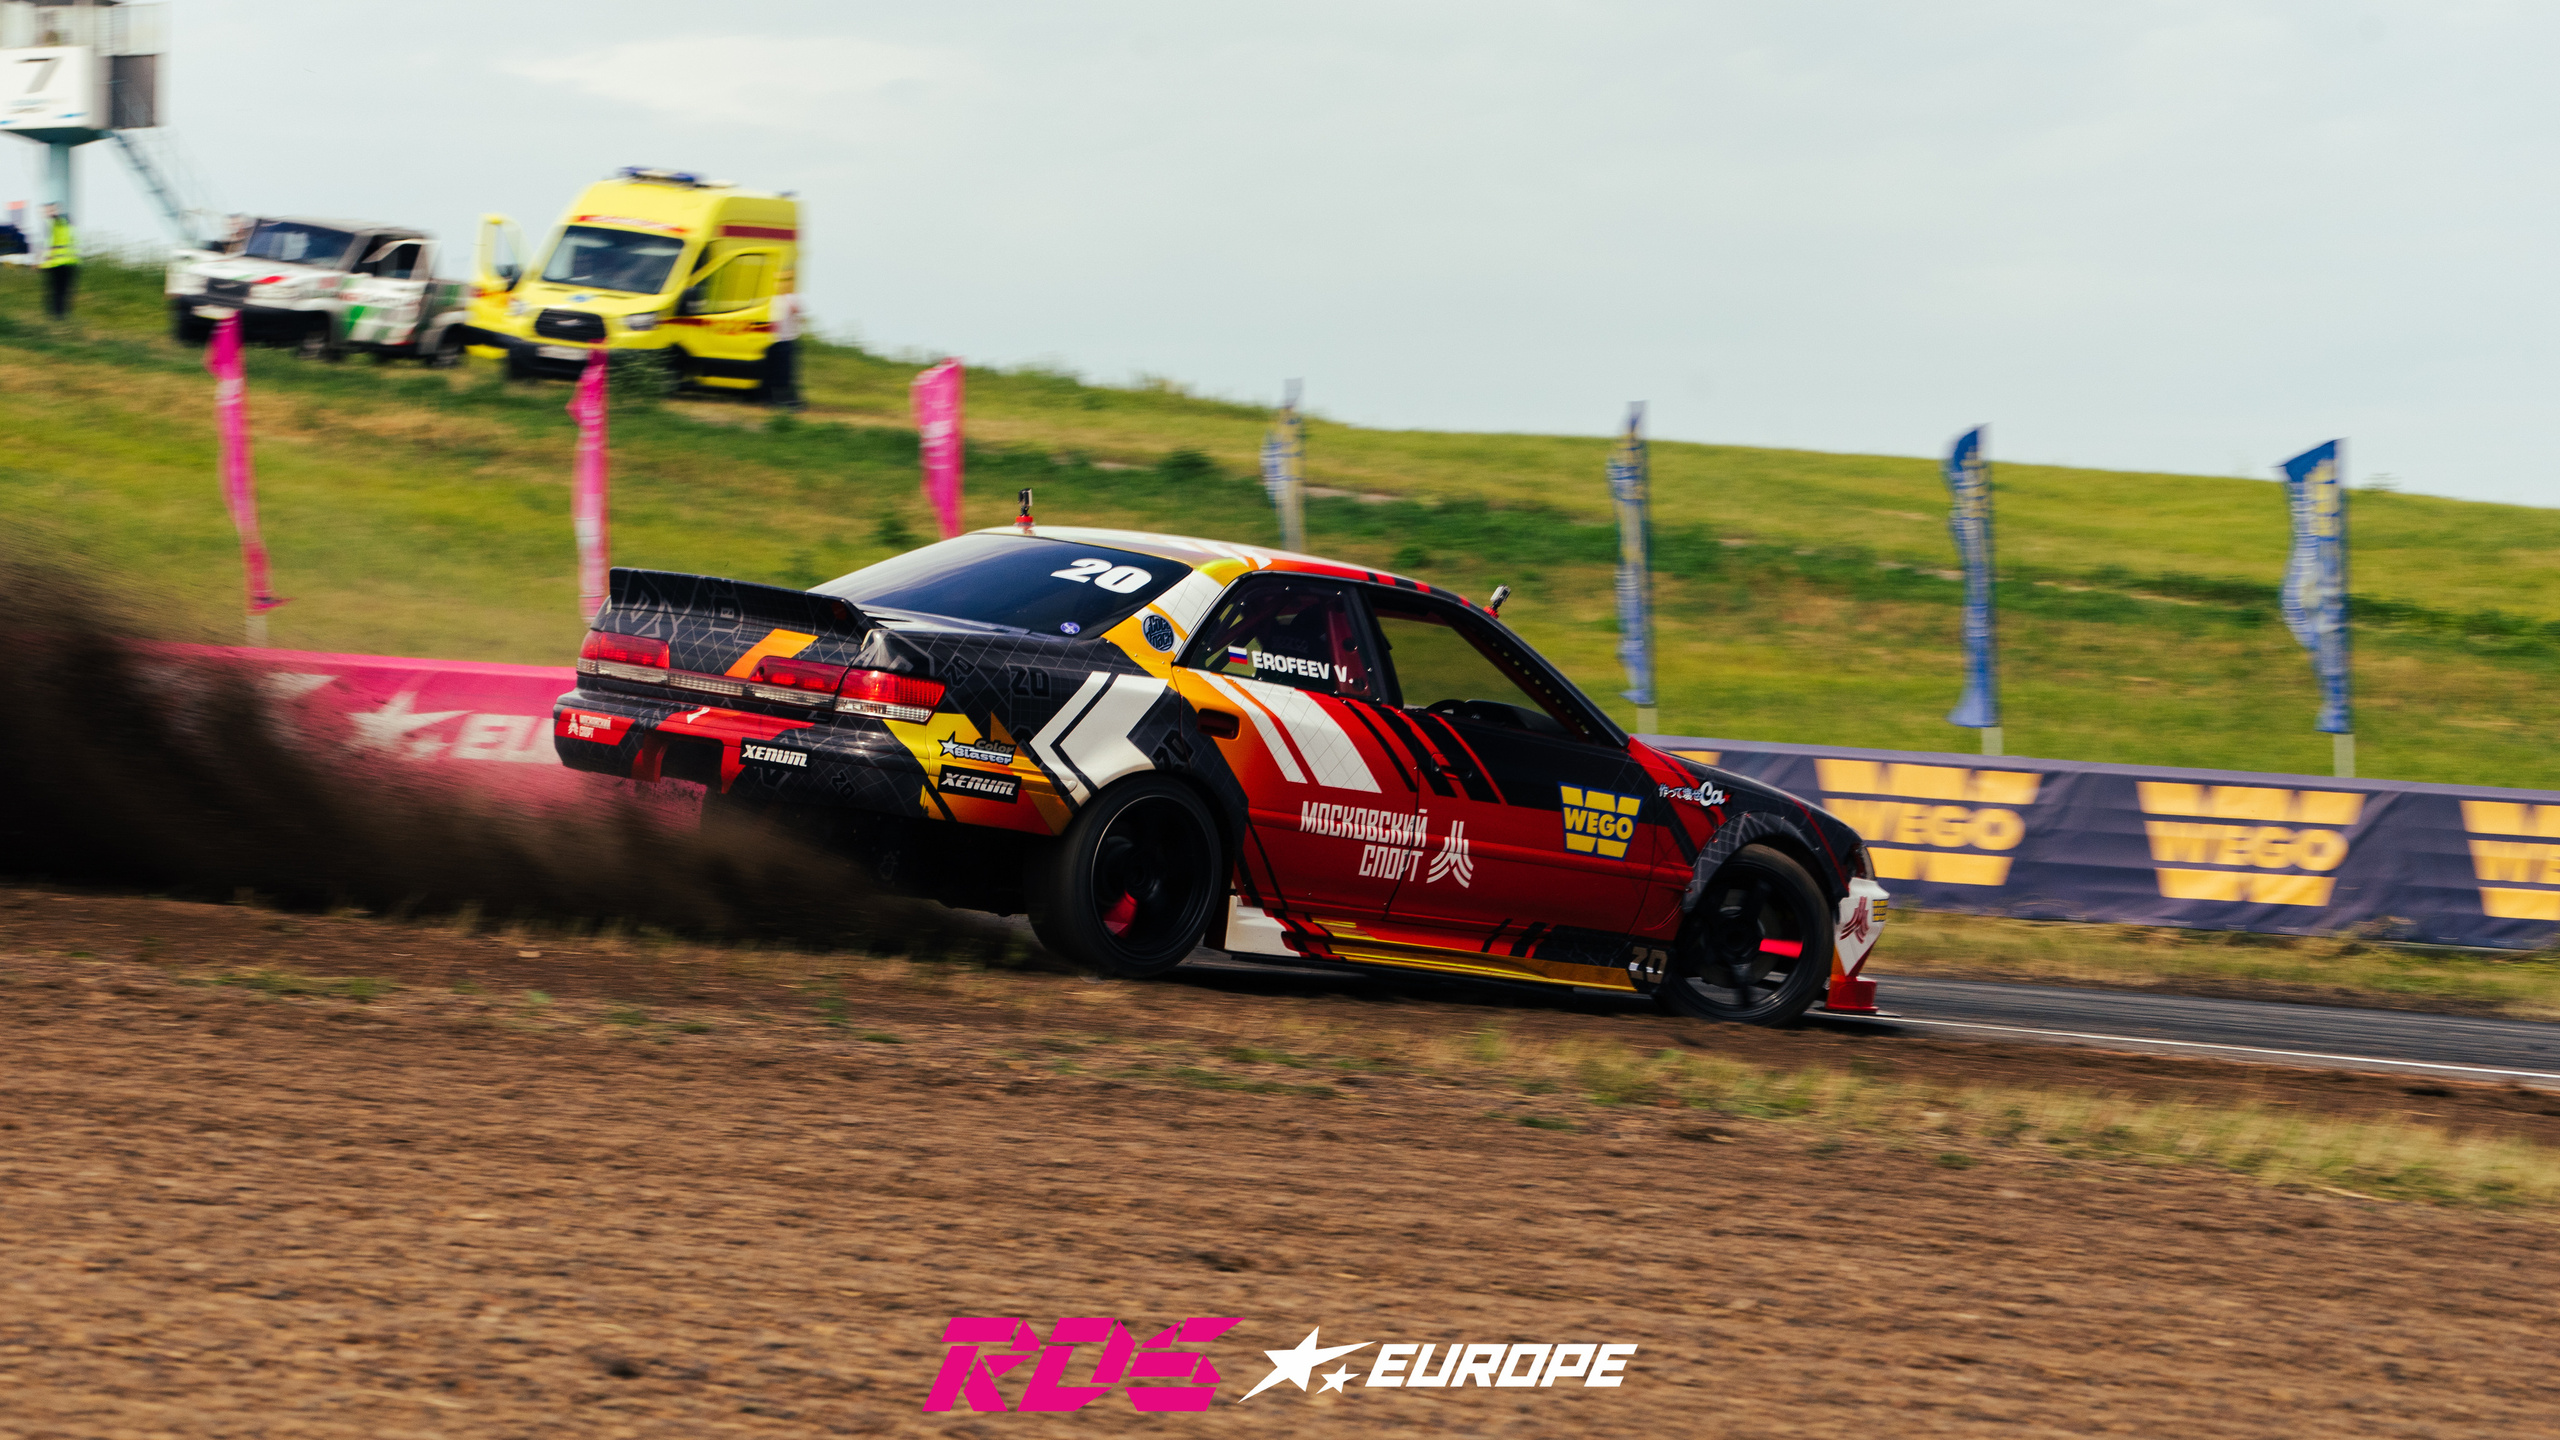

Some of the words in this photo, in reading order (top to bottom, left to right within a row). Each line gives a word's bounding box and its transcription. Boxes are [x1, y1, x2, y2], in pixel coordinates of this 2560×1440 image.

[17, 57, 62, 93] 7
[1050, 557, 1152, 594] 20
[1251, 650, 1330, 680] EROFEEV
[1333, 664, 1354, 683] V.
[742, 744, 808, 767] XENUM
[954, 747, 1012, 765] Blaster
[975, 739, 1016, 754] Color
[940, 772, 1016, 796] XENUM
[1299, 801, 1428, 848] МОСКОВСКИЙ
[1563, 807, 1634, 840] WEGO
[1822, 798, 2027, 851] WEGO
[1358, 844, 1424, 882] СПОРТ
[2143, 820, 2349, 871] WEGO
[1628, 946, 1668, 984] 20
